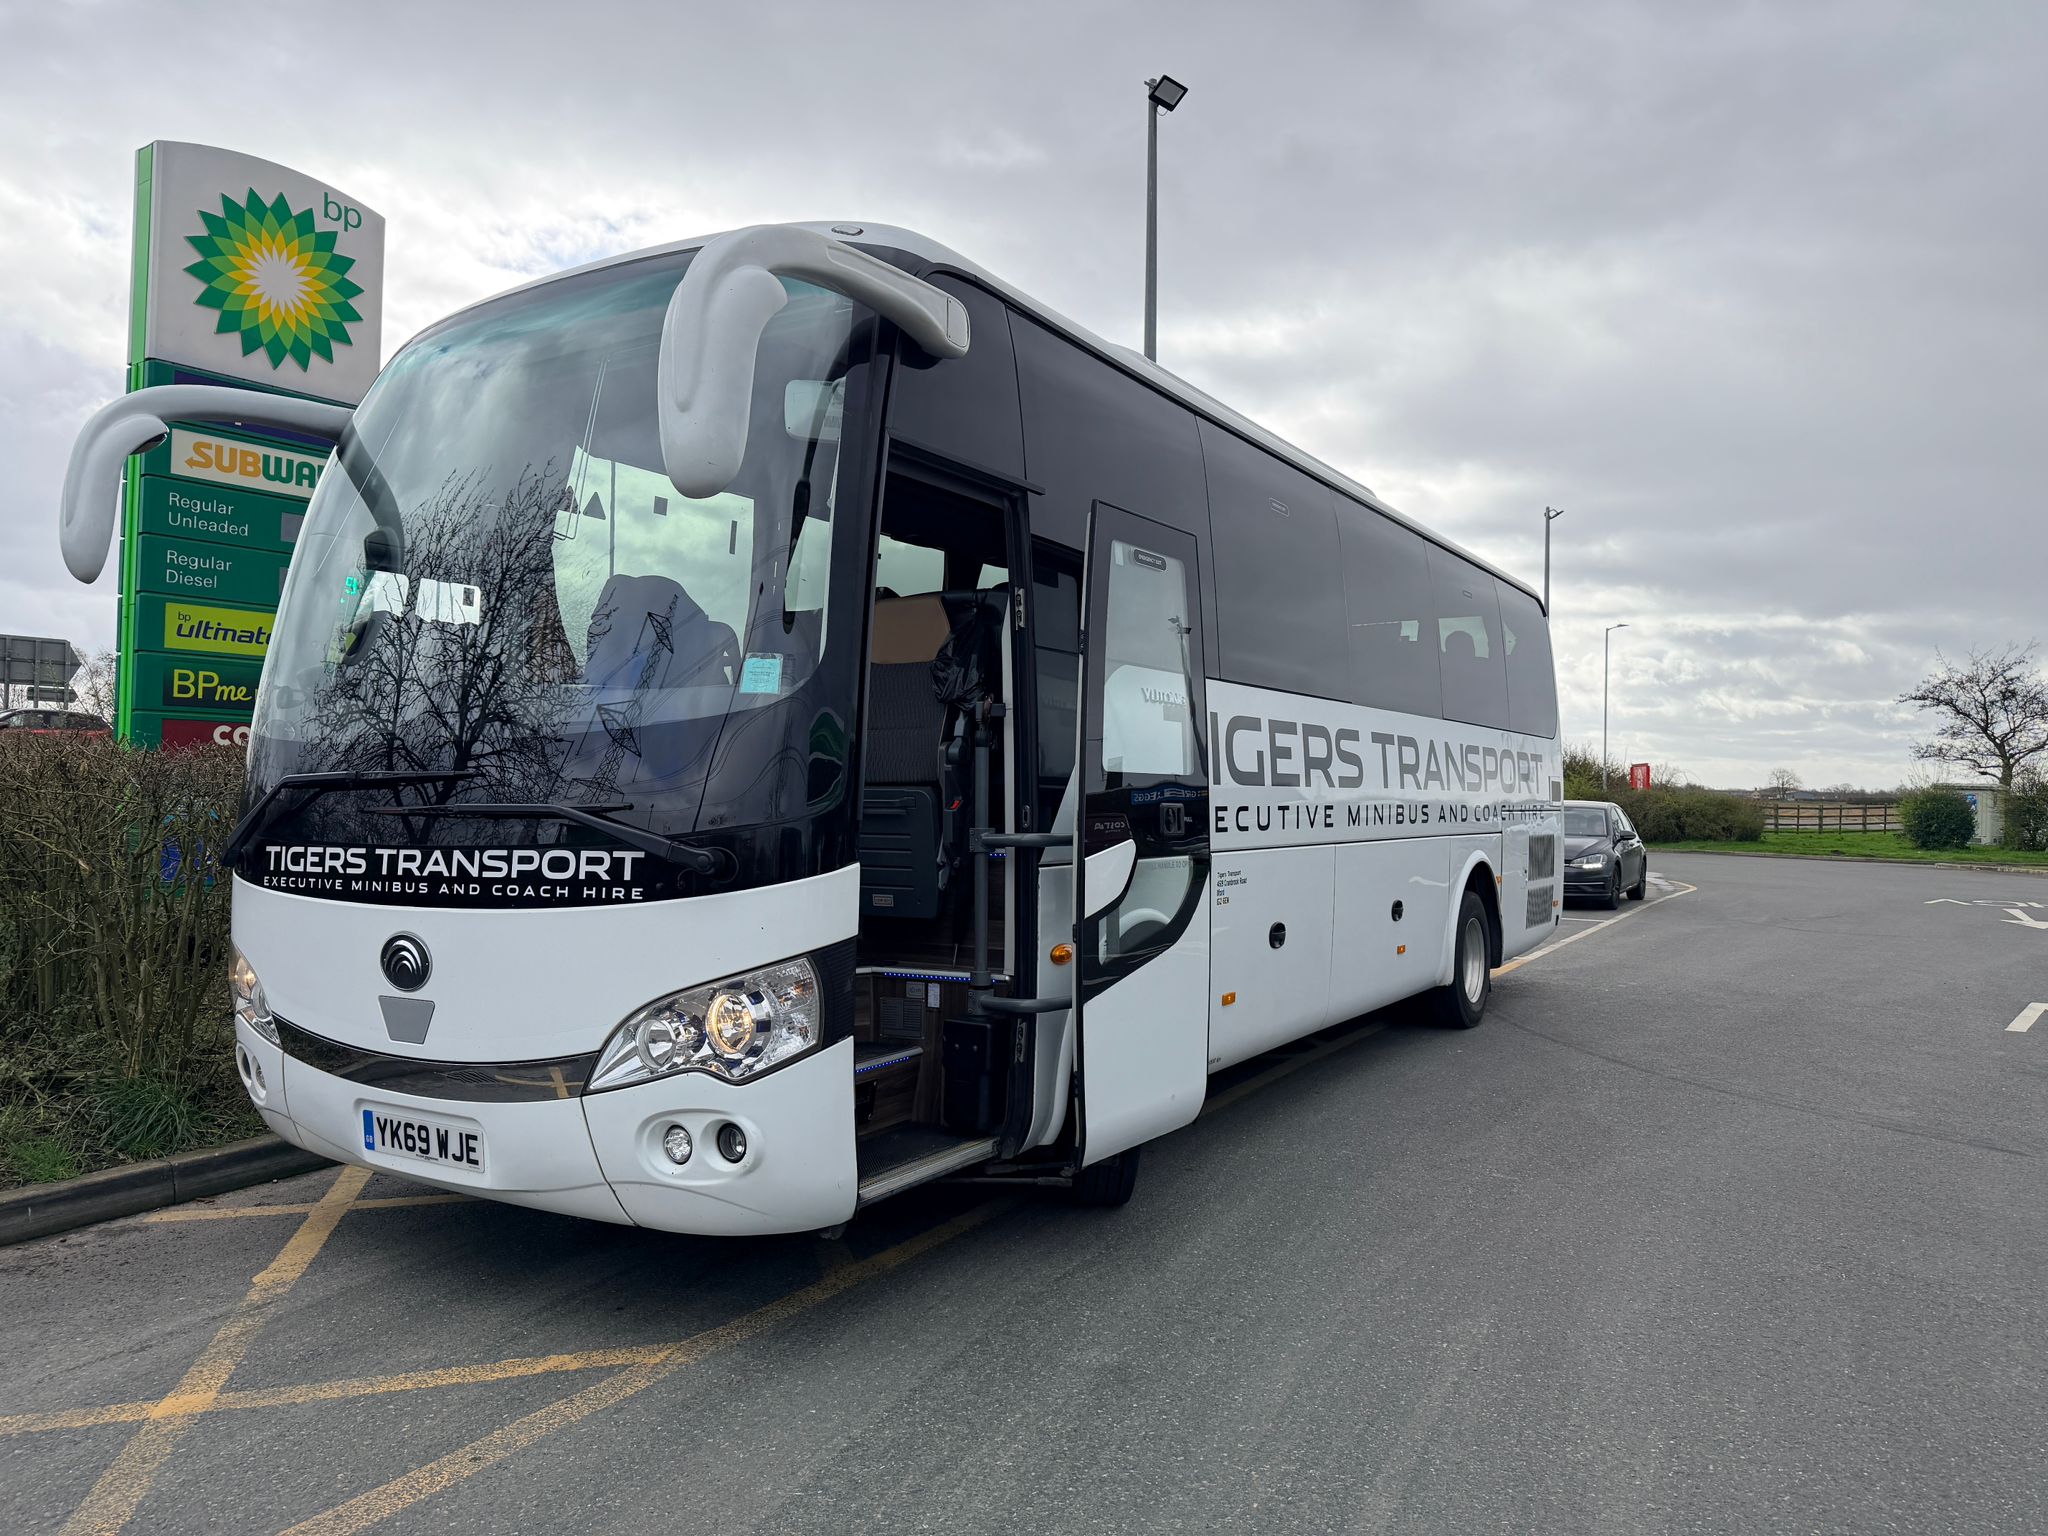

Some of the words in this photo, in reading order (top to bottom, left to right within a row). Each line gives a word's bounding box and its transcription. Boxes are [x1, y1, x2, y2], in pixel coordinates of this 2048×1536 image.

[323, 191, 362, 232] bp
[185, 441, 325, 489] SUBWA
[169, 492, 234, 515] Regular
[168, 511, 249, 537] Unleaded
[166, 549, 233, 572] Regular
[165, 568, 218, 589] Diesel
[177, 611, 192, 623] bp
[1370, 731, 1543, 796] TRANSPORT
[1347, 803, 1429, 827] MINIBUS
[1437, 804, 1468, 823] AND
[1474, 804, 1515, 822] COACH
[266, 845, 367, 874] TIGERS
[375, 848, 646, 881] TRANSPORT
[263, 875, 343, 891] EXECUTIVE
[351, 880, 428, 893] MINIBUS
[438, 883, 481, 896] AND
[492, 884, 569, 899] COACH
[583, 886, 644, 900] HIRE
[376, 1116, 430, 1155] YK69
[436, 1128, 479, 1166] WJE
